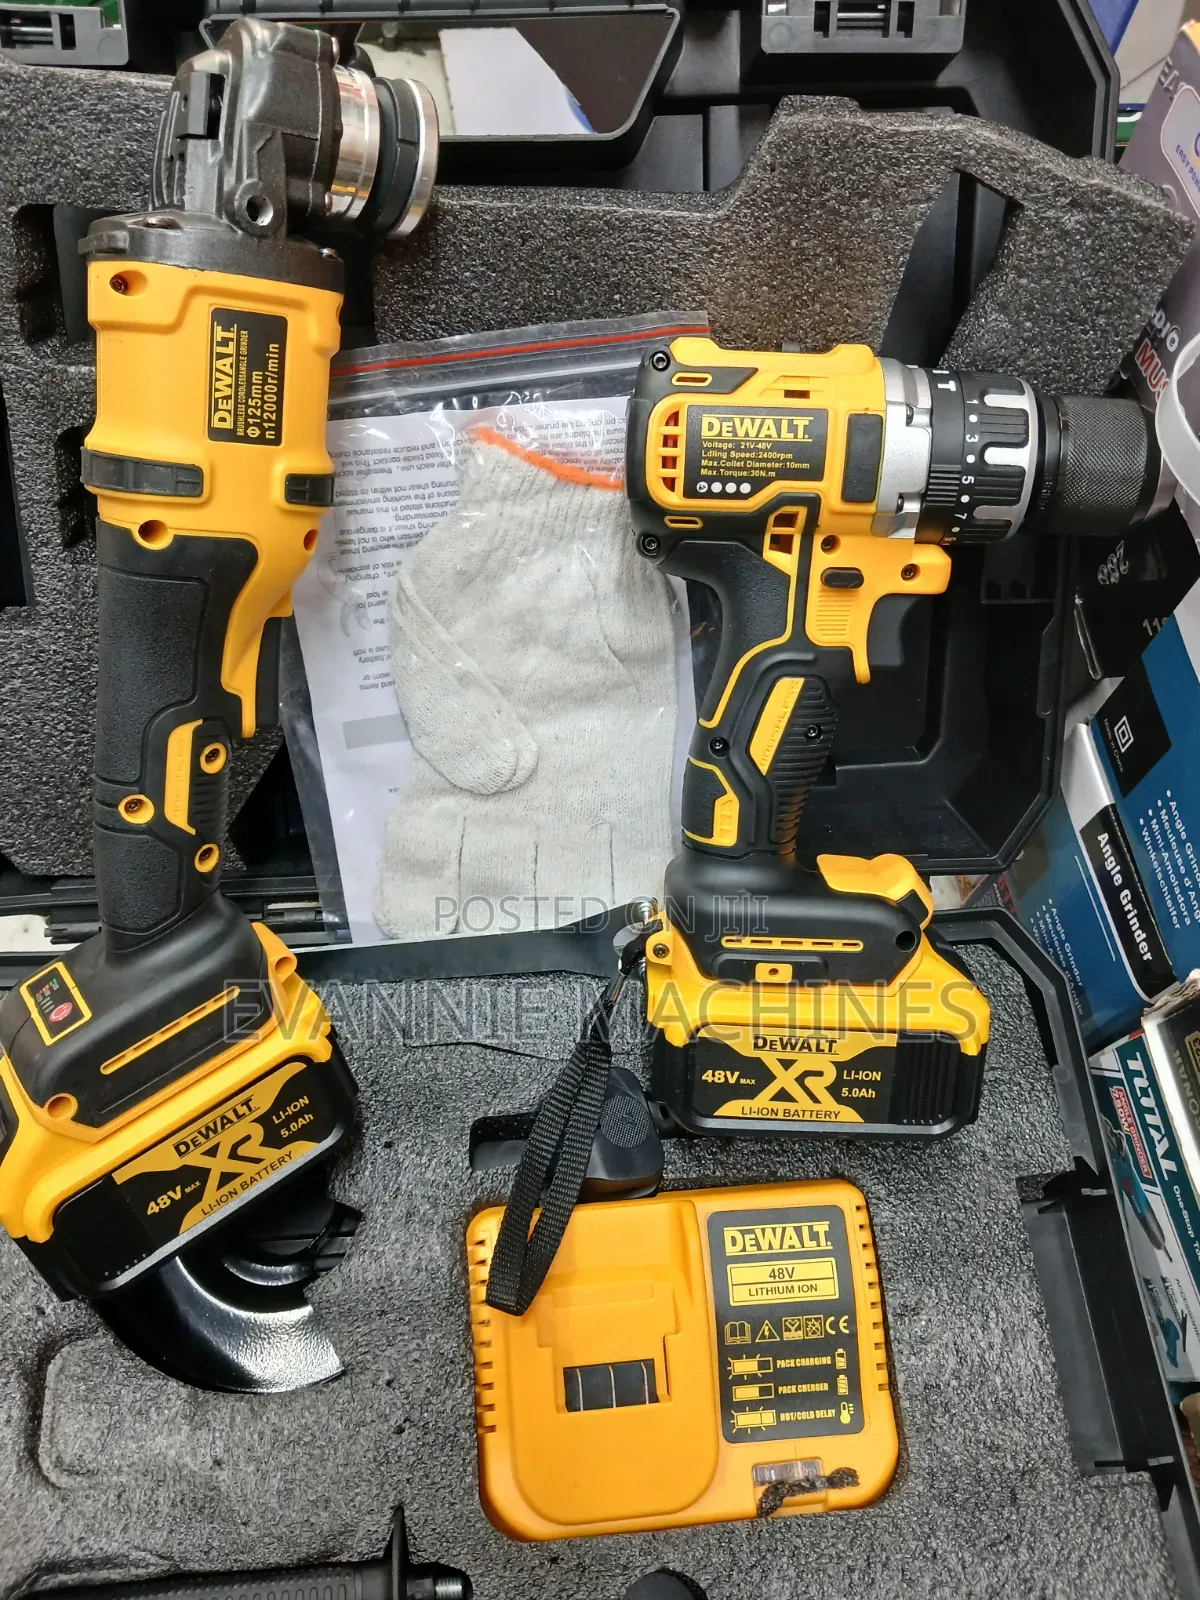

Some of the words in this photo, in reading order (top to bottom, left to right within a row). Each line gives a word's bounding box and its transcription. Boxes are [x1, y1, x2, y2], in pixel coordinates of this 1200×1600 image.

[966, 434, 979, 443] 3
[393, 446, 420, 454] reduce
[421, 443, 436, 451] and
[702, 441, 736, 450] Voltage:
[352, 448, 391, 458] resistance
[373, 457, 401, 465] contact
[403, 454, 424, 463] blade
[416, 463, 435, 471] each
[355, 468, 392, 477] thereafter
[961, 475, 975, 485] 5
[371, 487, 392, 495] within
[394, 485, 406, 493] not
[408, 483, 429, 492] shear
[335, 490, 358, 498] stated
[382, 494, 412, 504] working
[427, 492, 434, 500] of
[346, 508, 374, 516] manual
[339, 527, 378, 536] dangerous
[397, 532, 423, 541] person
[362, 545, 390, 553] pruning
[345, 573, 379, 583] changing
[373, 672, 390, 680] worn
[1169, 801, 1187, 840] Angle
[1160, 808, 1185, 874] Meuleuse
[1151, 818, 1191, 926] Mini-Amoladora
[1142, 826, 1181, 929] Winkelschleifer
[1097, 832, 1123, 887] Angle
[1119, 889, 1153, 962] Grinder
[1051, 907, 1065, 941] Angle
[1064, 942, 1083, 986] Grinder
[753, 1036, 837, 1053] DEWALT
[701, 1069, 740, 1084] 48V
[753, 1058, 838, 1105] XR
[843, 1070, 882, 1081] LI-ION
[841, 1087, 876, 1098] 5.0Ah
[272, 1095, 310, 1125] LI-ION
[741, 1106, 779, 1117] LI-ION
[782, 1107, 841, 1119] BATTERY
[173, 1097, 256, 1159] DEWALT
[280, 1113, 314, 1138] 5.0Ah
[1117, 1088, 1132, 1124] ANGLE
[1130, 1125, 1149, 1174] GRINDER
[201, 1187, 239, 1216] LI-ION
[239, 1150, 294, 1192] BATTERY
[146, 1184, 183, 1216] 48V
[184, 1180, 202, 1194] MAX
[768, 1266, 795, 1280] 48V
[748, 1285, 795, 1297] LITHIUM
[797, 1283, 818, 1293] ION
[776, 1358, 795, 1368] PACK
[795, 1356, 832, 1367] CHARGING
[778, 1384, 797, 1394] PACK
[780, 1411, 815, 1422] HOT/COLD
[815, 1409, 836, 1418] DELAY
